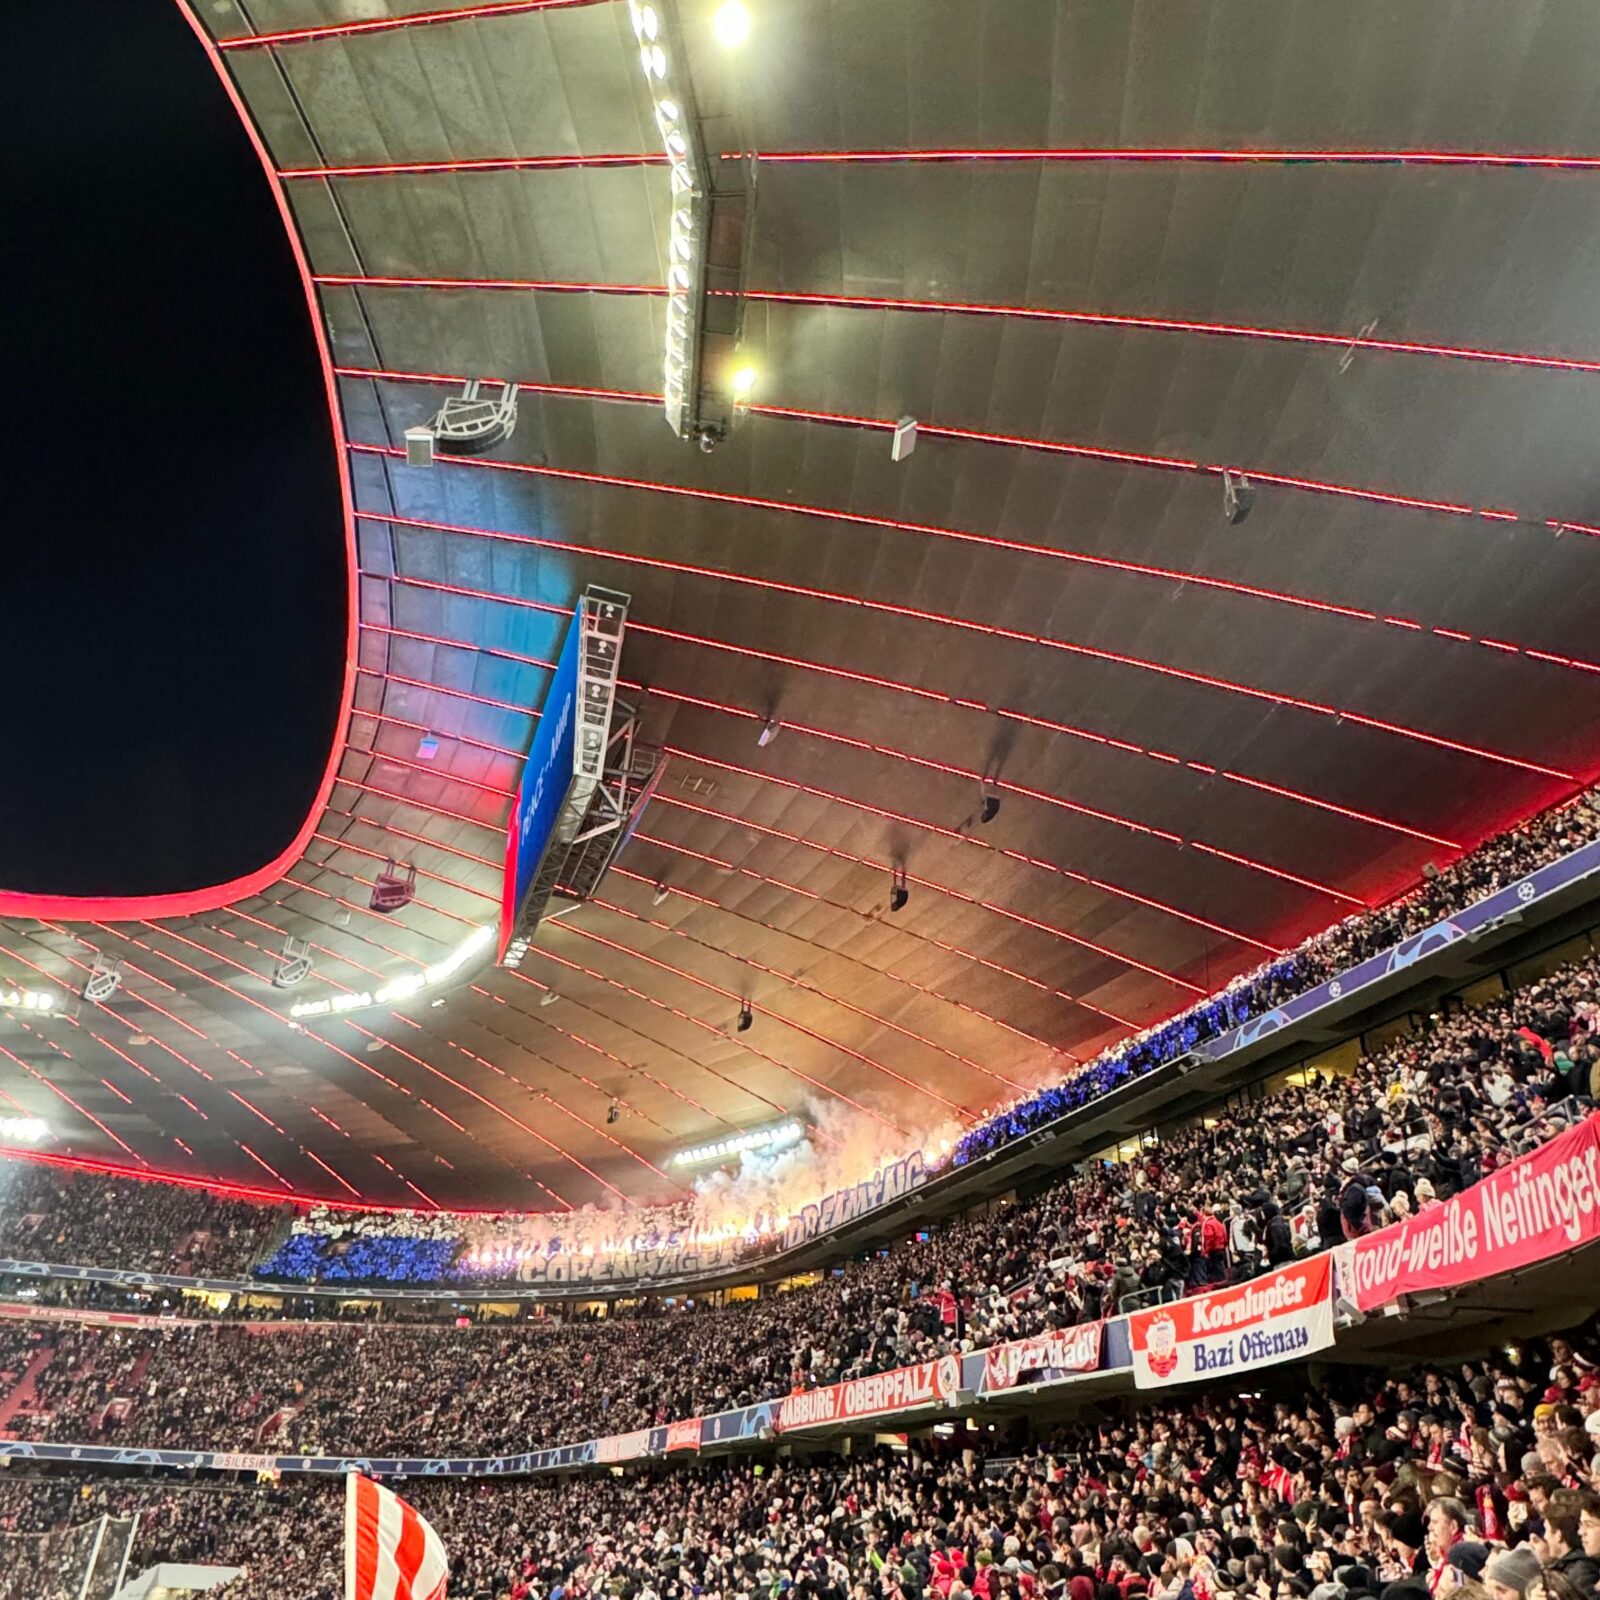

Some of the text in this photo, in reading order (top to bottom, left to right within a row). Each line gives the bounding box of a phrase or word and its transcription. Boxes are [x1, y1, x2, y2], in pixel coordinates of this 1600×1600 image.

[1192, 1275, 1307, 1333] Kornlupfer
[1193, 1325, 1308, 1372] Bazi Offenau
[780, 1389, 834, 1427] NABBURG
[845, 1363, 933, 1414] OBERPFALZ
[224, 1456, 266, 1468] SILESIA
